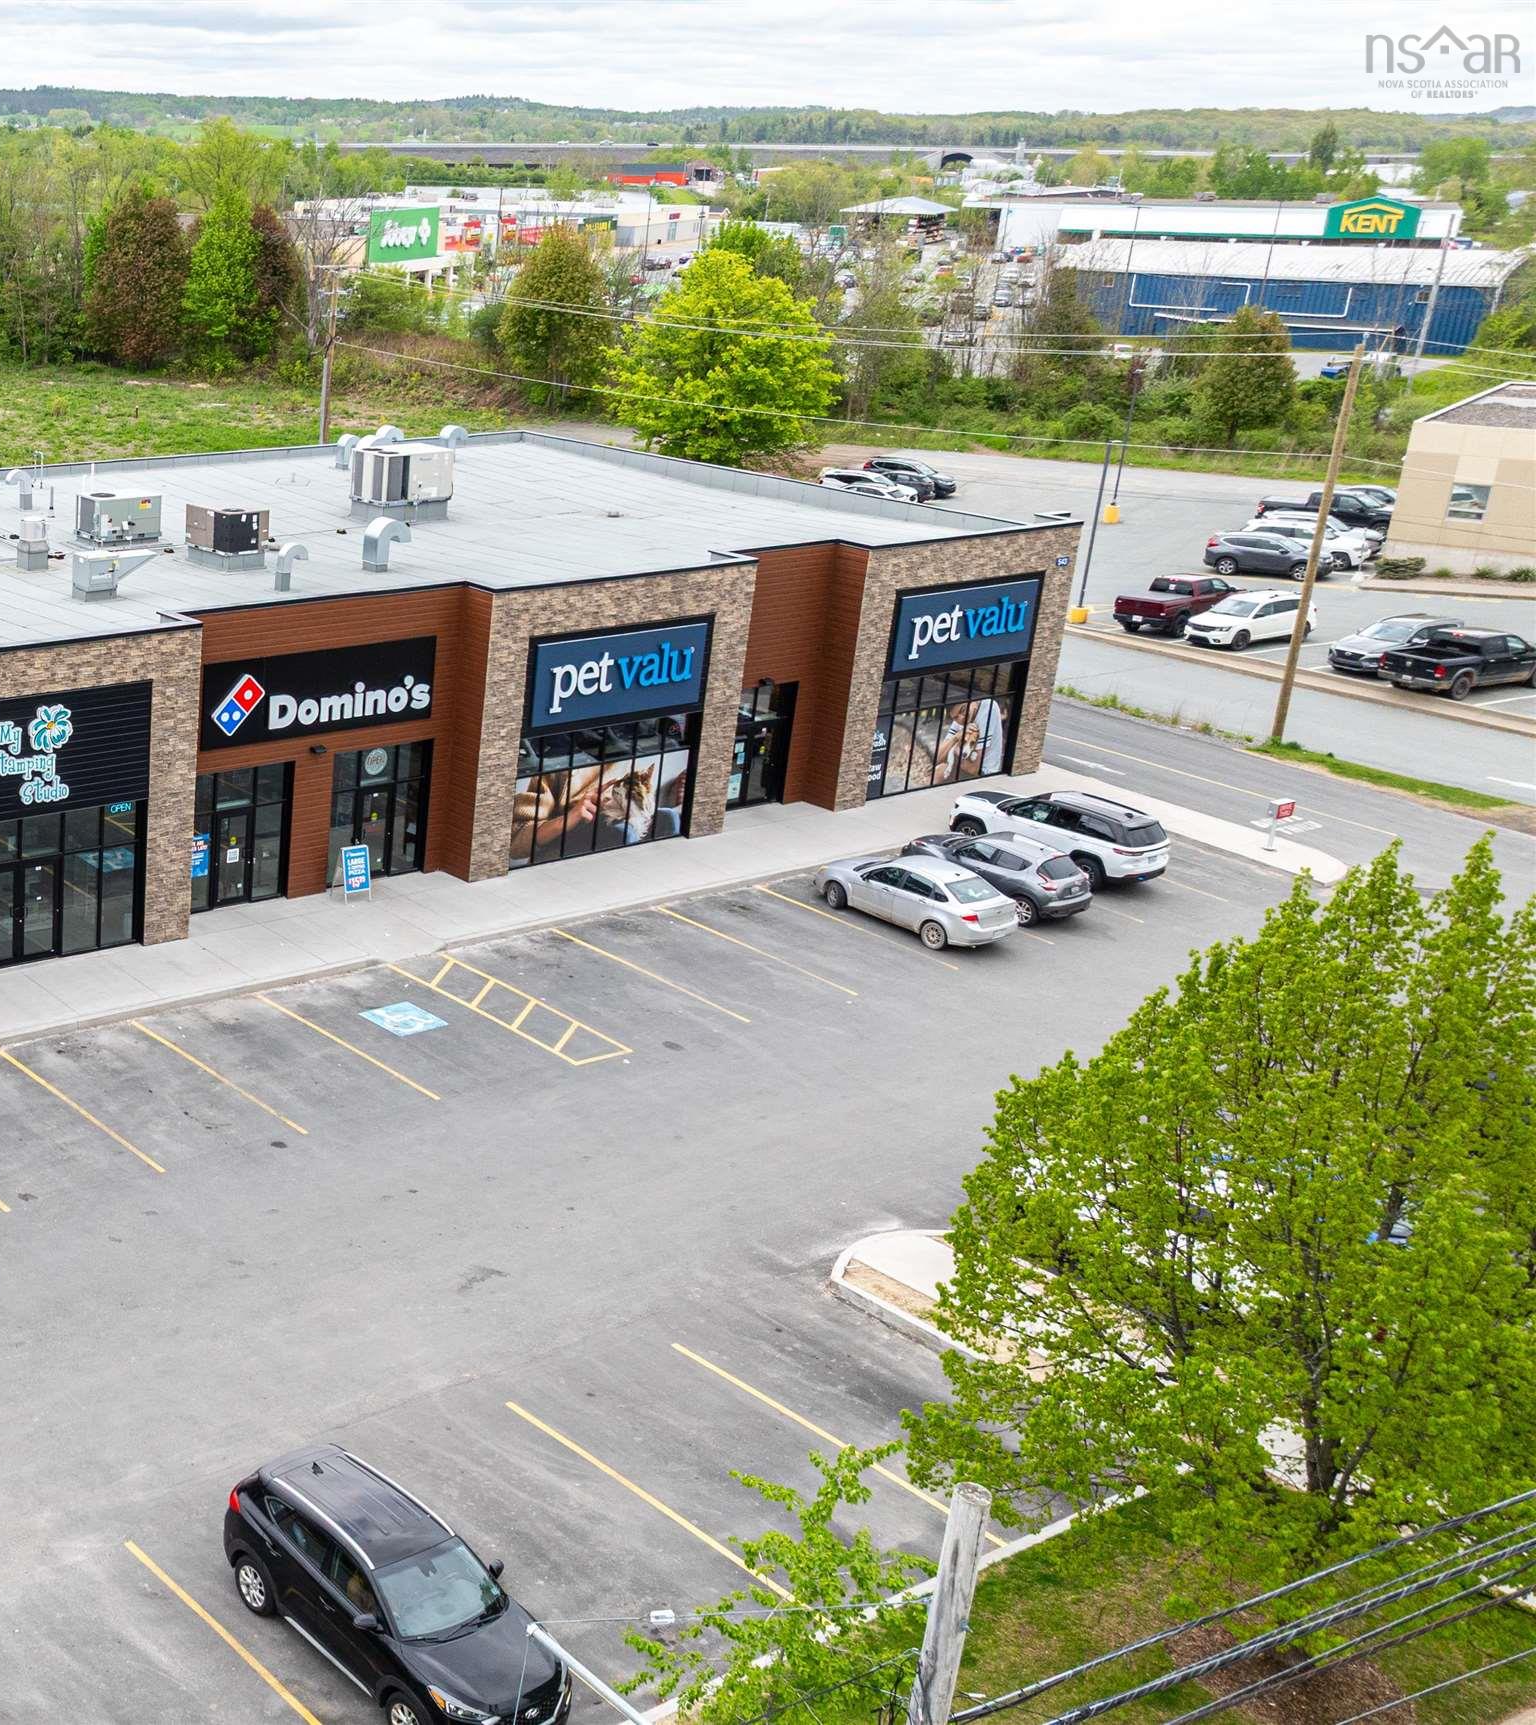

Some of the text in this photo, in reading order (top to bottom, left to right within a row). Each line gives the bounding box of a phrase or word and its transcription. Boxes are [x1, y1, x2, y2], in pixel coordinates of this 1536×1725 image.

[1340, 213, 1403, 233] KENT
[908, 596, 1027, 660] pet valu
[549, 640, 693, 714] pet valu
[268, 674, 431, 730] Domino's
[20, 775, 69, 804] Studio
[110, 802, 132, 813] OPEN
